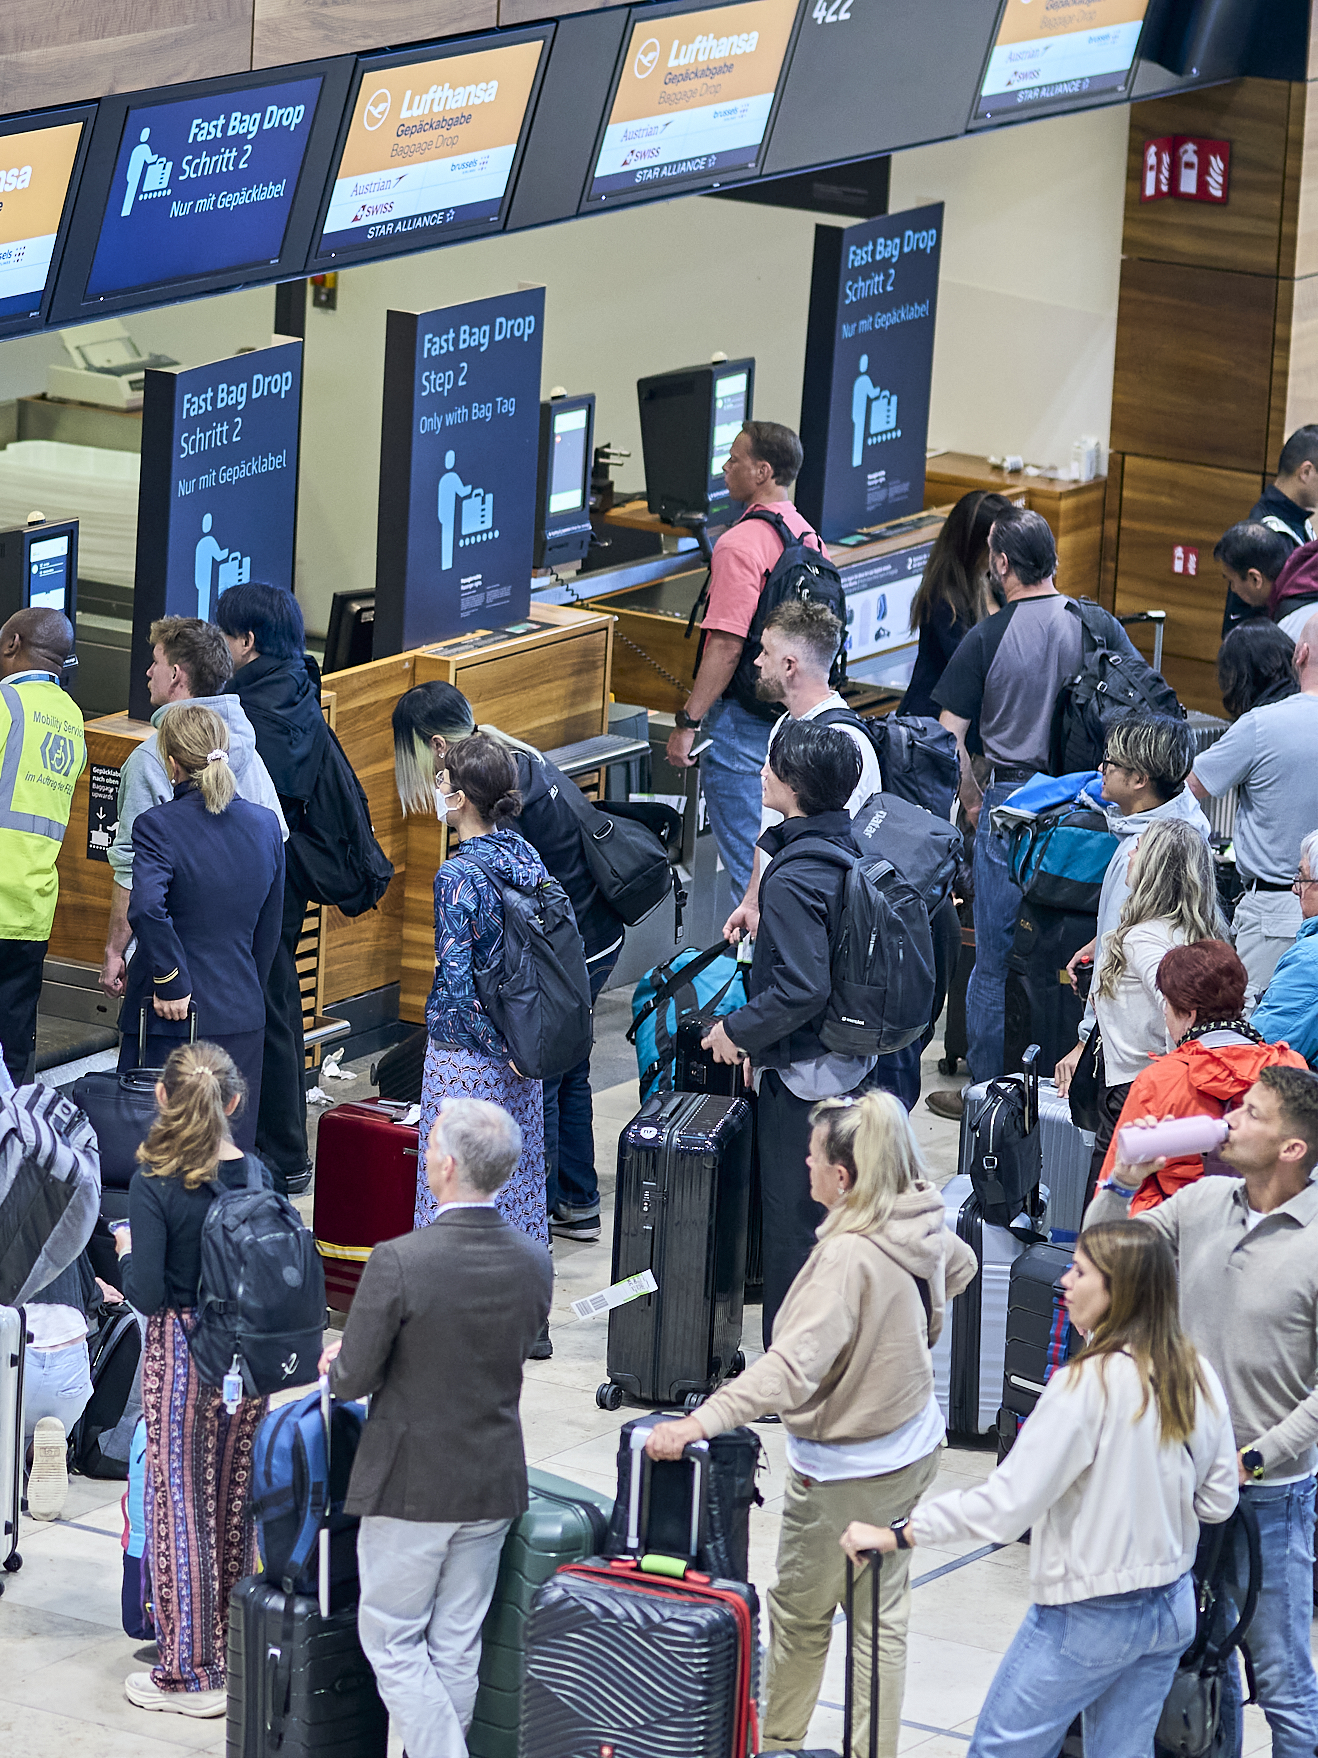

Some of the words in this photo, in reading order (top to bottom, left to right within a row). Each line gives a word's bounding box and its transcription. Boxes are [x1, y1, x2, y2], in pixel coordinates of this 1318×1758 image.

[812, 0, 853, 24] 422
[667, 30, 760, 68] Lufthansa
[664, 61, 734, 86] Gepäckabgabe
[400, 79, 499, 119] Lufthansa
[658, 86, 699, 106] Baggage
[700, 81, 722, 99] Drop
[188, 112, 225, 143] Fast
[227, 110, 261, 139] Bag
[263, 103, 305, 133] Drop
[396, 111, 472, 138] Gepäckabgabe
[713, 106, 738, 119] brussels
[621, 122, 659, 143] Austrian
[390, 138, 434, 159] Baggage
[436, 134, 459, 150] Drop
[634, 146, 660, 162] SWISS
[179, 148, 236, 180] Schritt
[239, 144, 252, 170] 2
[450, 158, 478, 172] brussels
[635, 166, 660, 183] STAR
[661, 157, 706, 179] ALLIANCE
[169, 199, 192, 219] Nur
[195, 193, 215, 212] mit
[217, 179, 286, 212] Gepäcklabel
[350, 177, 392, 198] Austrian
[365, 201, 394, 217] SWISS
[367, 221, 393, 239] STAR
[394, 213, 443, 235] ALLIANCE
[848, 239, 873, 270] Fast
[876, 235, 900, 262] Bag
[904, 227, 936, 255] Drop
[844, 273, 884, 306] Schritt
[887, 269, 896, 292] 2
[842, 321, 856, 339] Nur
[858, 314, 873, 334] mit
[875, 299, 929, 332] Gepäcklabel
[423, 328, 455, 359] Fast
[459, 324, 490, 352] Bag
[494, 313, 535, 344] Drop
[421, 371, 454, 398] Step
[458, 363, 468, 386] 2
[182, 389, 213, 420] Fast
[217, 382, 247, 410] Bag
[251, 370, 293, 400] Drop
[419, 413, 442, 436] Only
[445, 406, 468, 428] with
[471, 402, 492, 421] Bag
[495, 396, 516, 417] Tag
[179, 424, 229, 458] Schritt
[232, 417, 242, 442] 2
[178, 478, 196, 498] Nur
[199, 471, 216, 490] mit
[218, 449, 286, 485] Gepäcklabel
[33, 710, 62, 732] Mobility
[25, 771, 35, 782] im
[37, 774, 57, 790] Auftrag
[92, 766, 121, 778] Gepäcklabe
[92, 792, 114, 800] upwards
